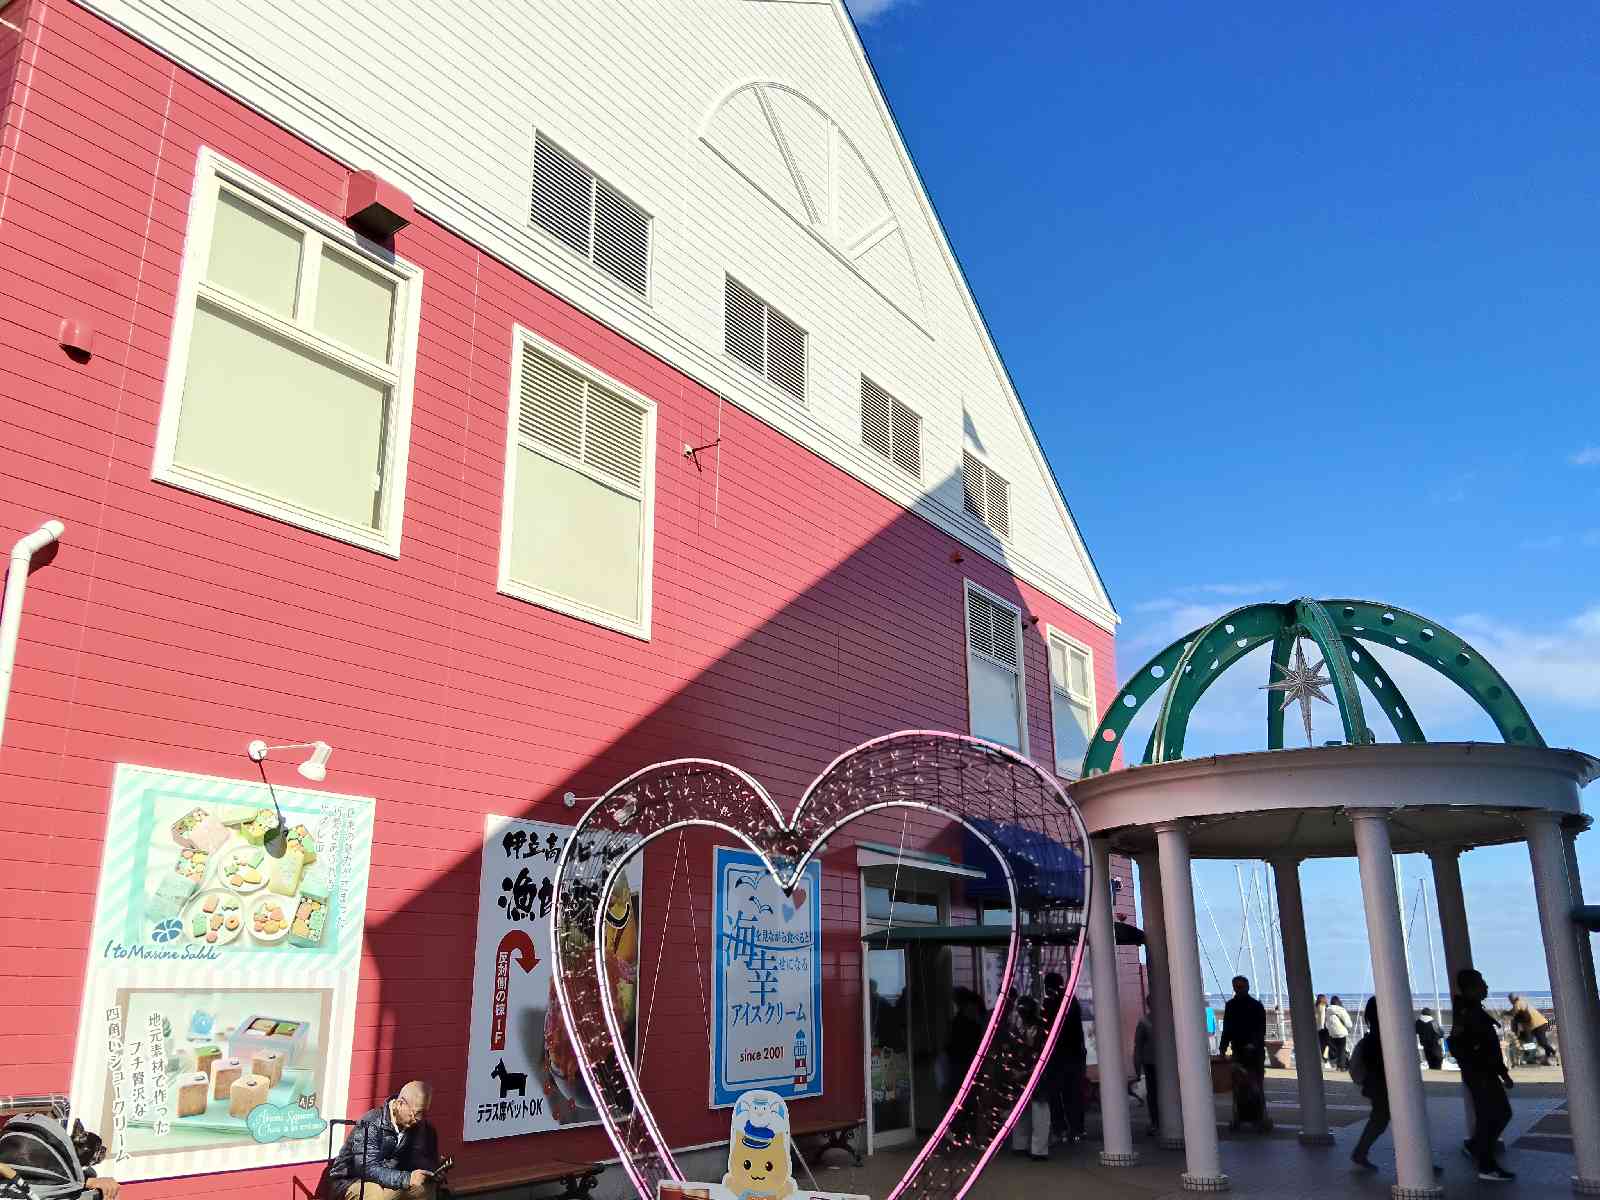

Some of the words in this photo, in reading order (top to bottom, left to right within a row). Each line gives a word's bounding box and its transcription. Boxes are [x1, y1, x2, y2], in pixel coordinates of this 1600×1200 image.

[731, 1002, 807, 1026] アイスクリーム
[739, 1050, 762, 1063] since
[763, 1046, 784, 1060] 2001
[149, 1012, 169, 1135] 地元素材で作った
